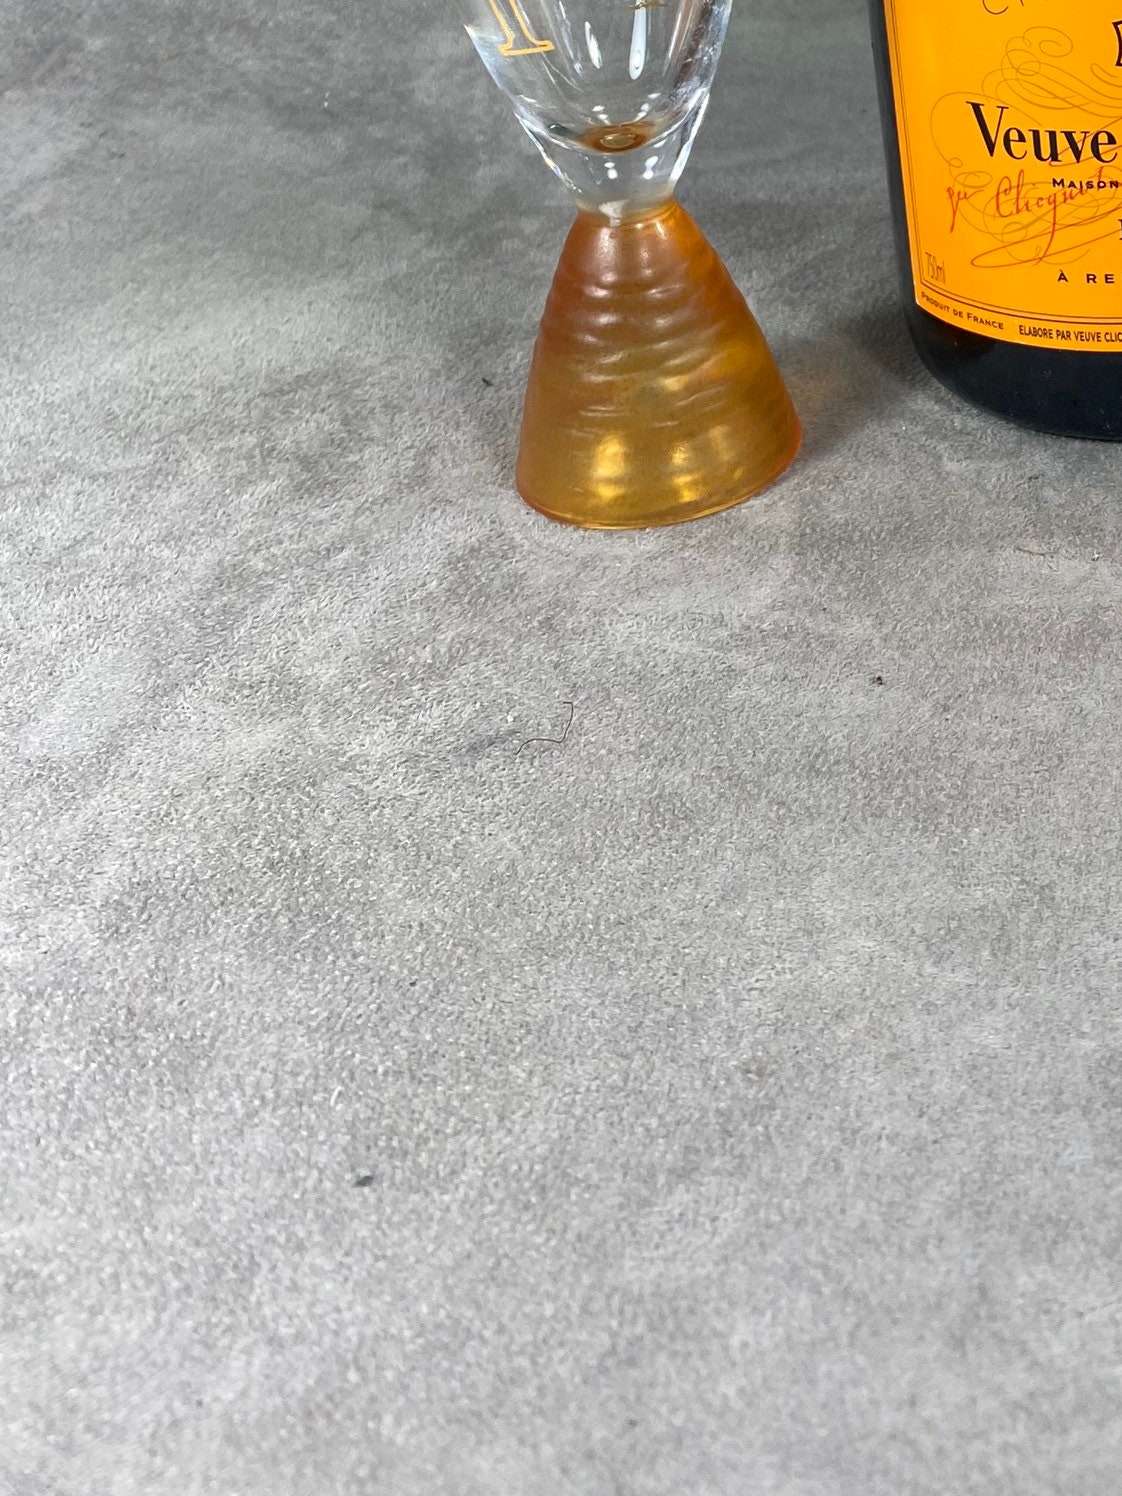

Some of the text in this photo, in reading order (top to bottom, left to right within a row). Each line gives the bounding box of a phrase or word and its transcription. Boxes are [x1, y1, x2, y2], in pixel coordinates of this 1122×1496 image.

[965, 101, 1118, 163] Veuve
[1057, 270, 1069, 283] À
[967, 312, 1004, 330] FRANCE
[1019, 325, 1053, 339] ELABORE
[1056, 330, 1072, 341] PAR
[1074, 331, 1101, 342] VEUVE
